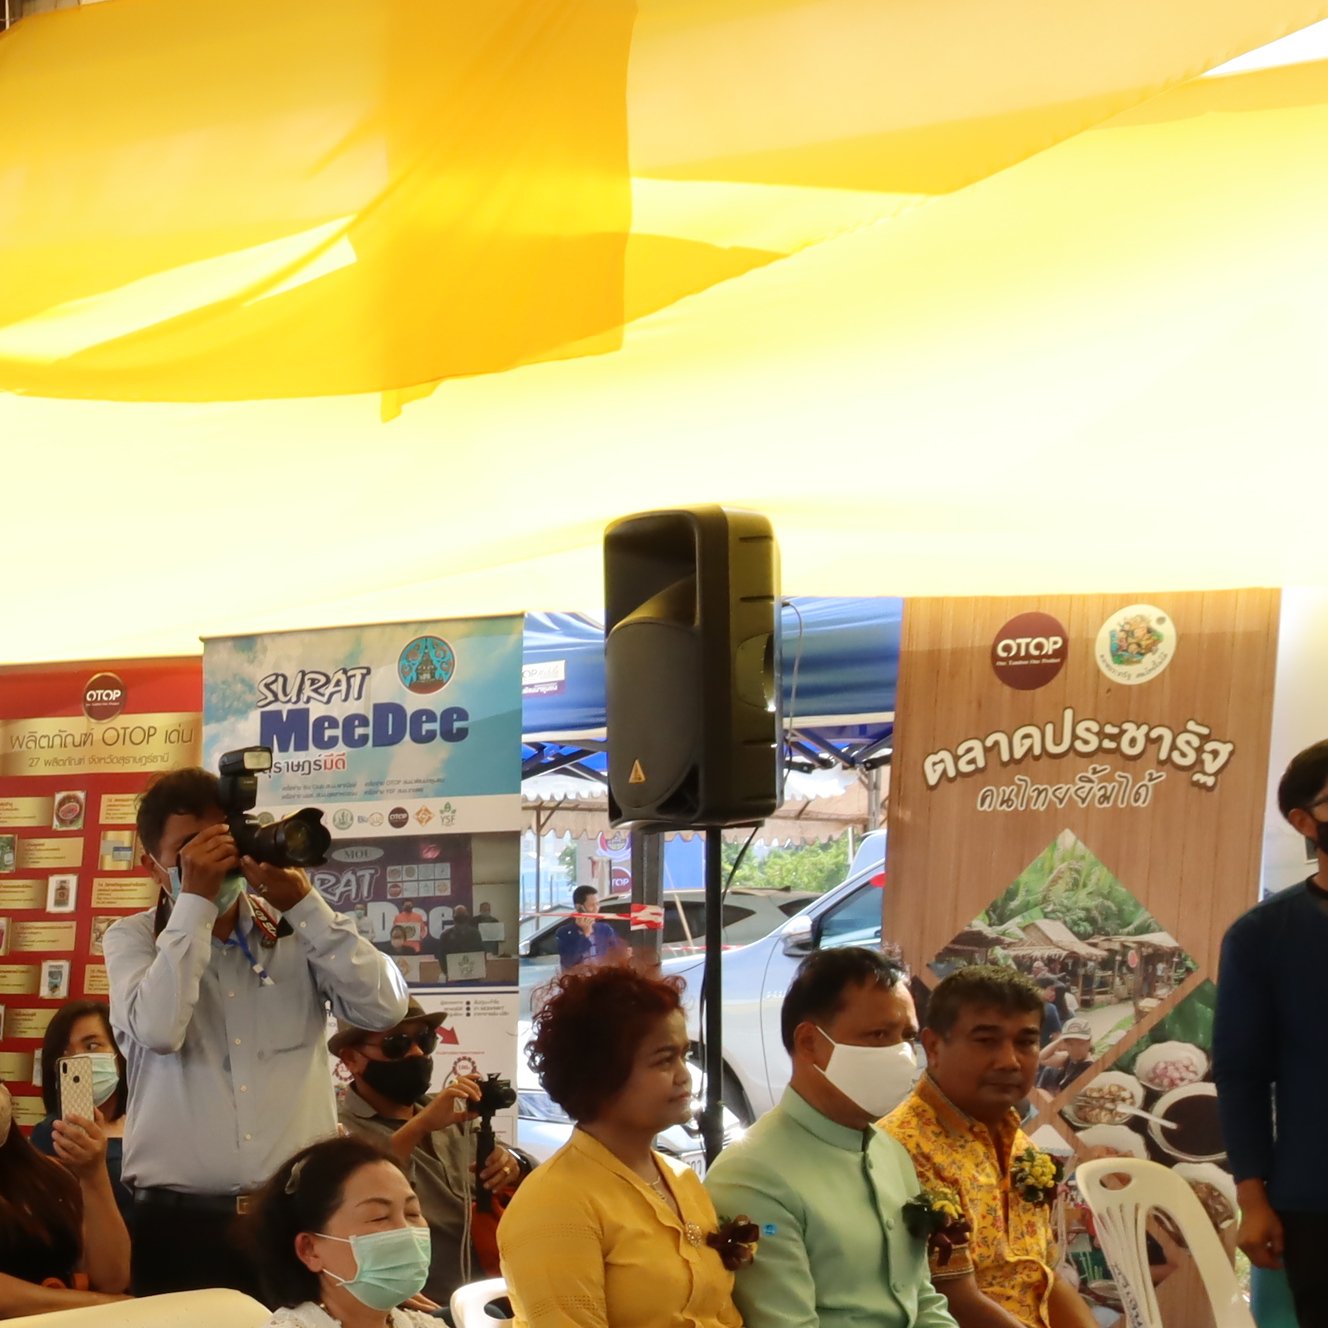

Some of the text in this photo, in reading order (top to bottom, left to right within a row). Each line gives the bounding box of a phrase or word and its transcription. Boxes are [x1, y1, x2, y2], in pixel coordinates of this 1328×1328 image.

[996, 636, 1063, 658] OTOP
[522, 669, 537, 678] OP
[86, 689, 121, 701] OTOP
[256, 666, 372, 708] SURAT
[10, 724, 193, 750] ผลิตภัณฑ์ OTOP เด่น
[260, 702, 469, 753] MeeDee
[923, 706, 1234, 788] ตลาดประชารัฐ
[28, 757, 40, 767] 27
[262, 752, 346, 779] ุราษฎร์มีดี
[977, 764, 1167, 812] คนไทยยิ้มได้
[345, 849, 372, 859] MOU
[612, 878, 630, 886] TOP
